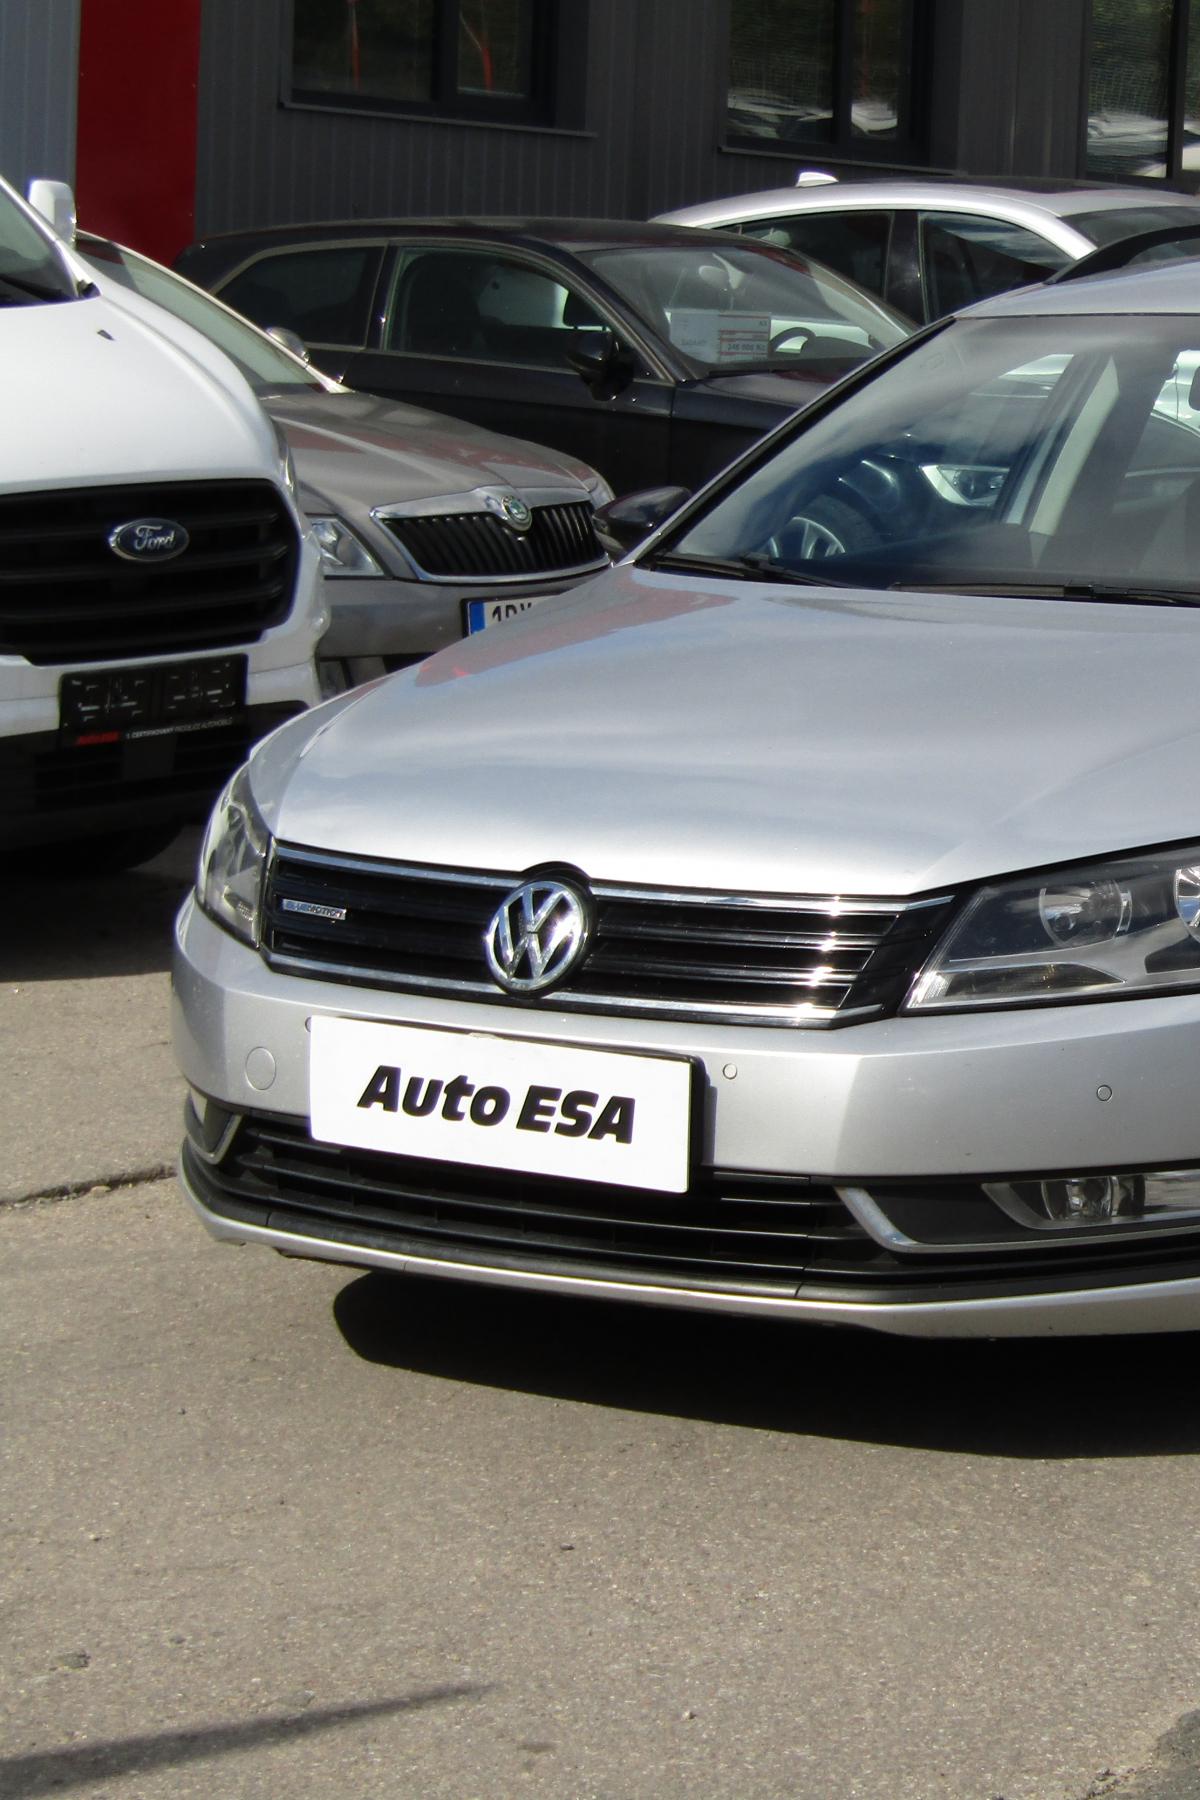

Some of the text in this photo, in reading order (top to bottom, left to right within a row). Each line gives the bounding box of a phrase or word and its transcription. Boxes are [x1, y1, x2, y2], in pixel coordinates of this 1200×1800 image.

[133, 524, 176, 551] Ford
[357, 1064, 636, 1145] Auto ESA
